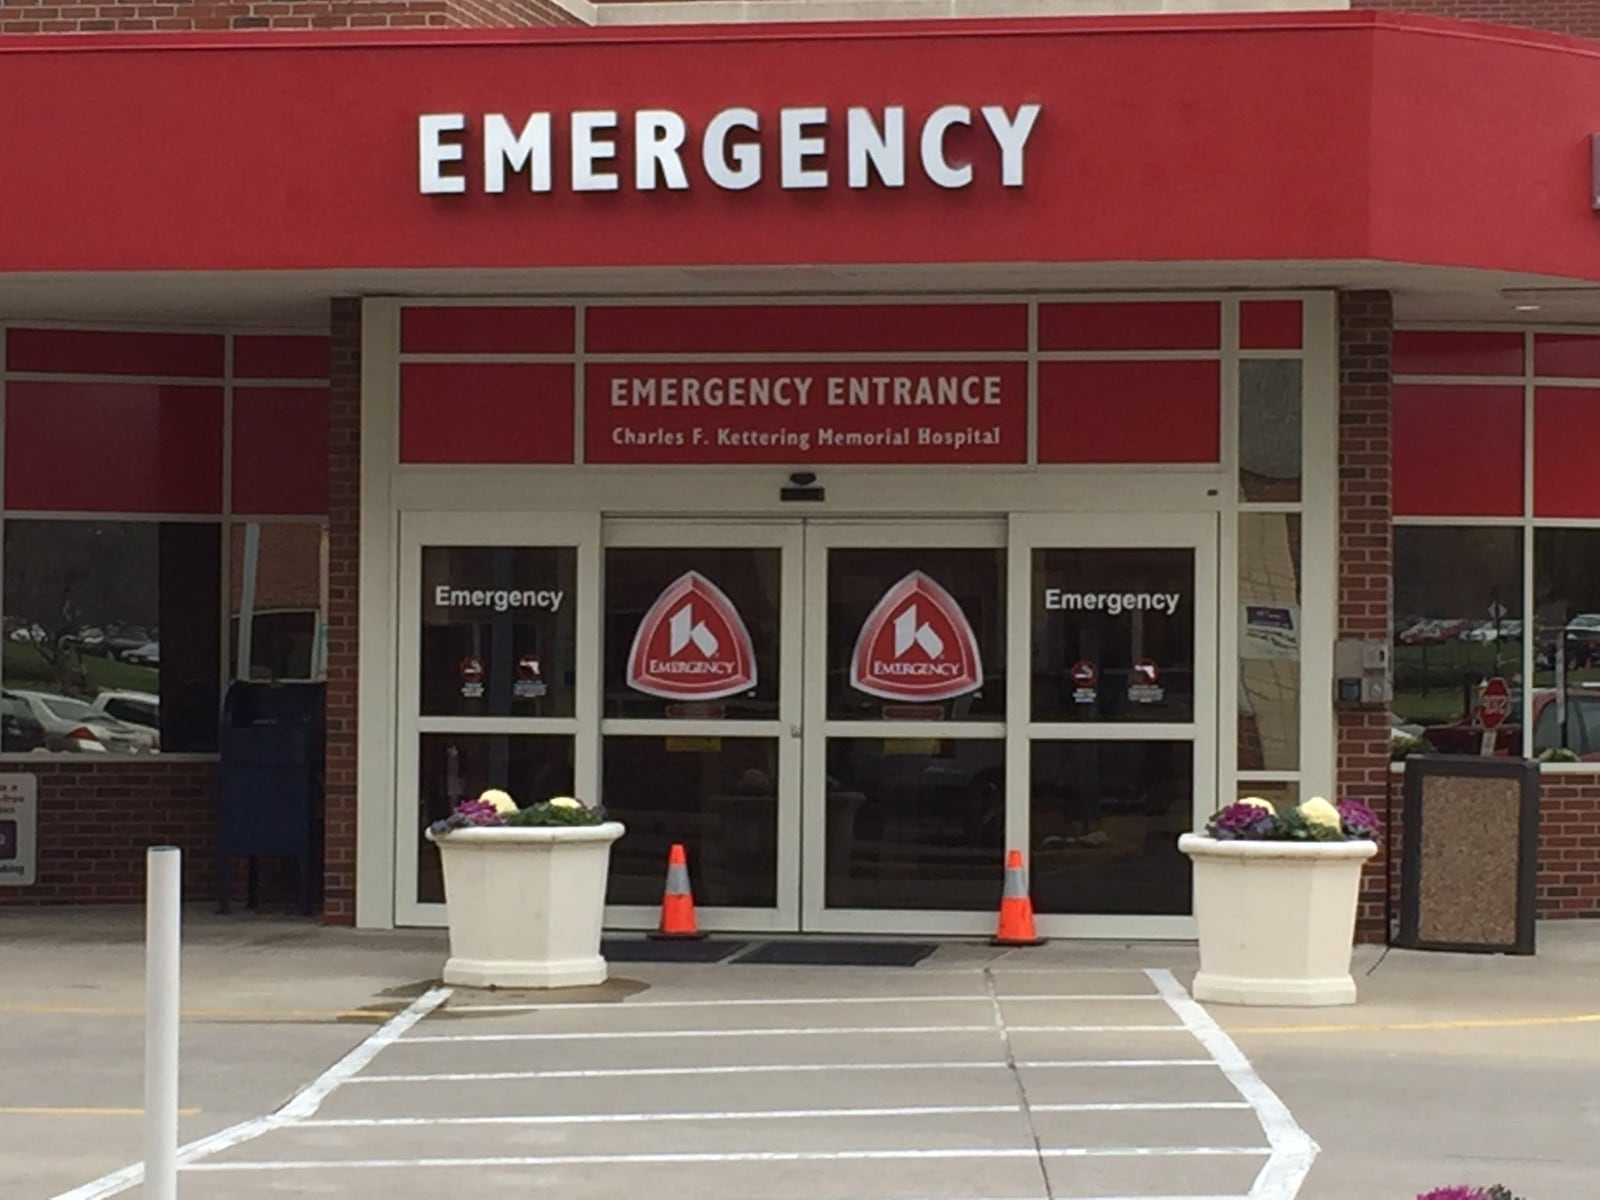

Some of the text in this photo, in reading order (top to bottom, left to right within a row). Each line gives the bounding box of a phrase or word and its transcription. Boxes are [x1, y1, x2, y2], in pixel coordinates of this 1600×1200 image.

[419, 104, 1041, 194] EMERGENCY
[611, 376, 1001, 407] EMERGENCY ENTRANCE
[612, 427, 1000, 451] Charles F. Kettering Memorial Hospital
[435, 585, 564, 612] Emergency
[1045, 588, 1180, 615] Emergency
[649, 659, 735, 675] EMERGENCY
[873, 660, 960, 676] EMERGENCY
